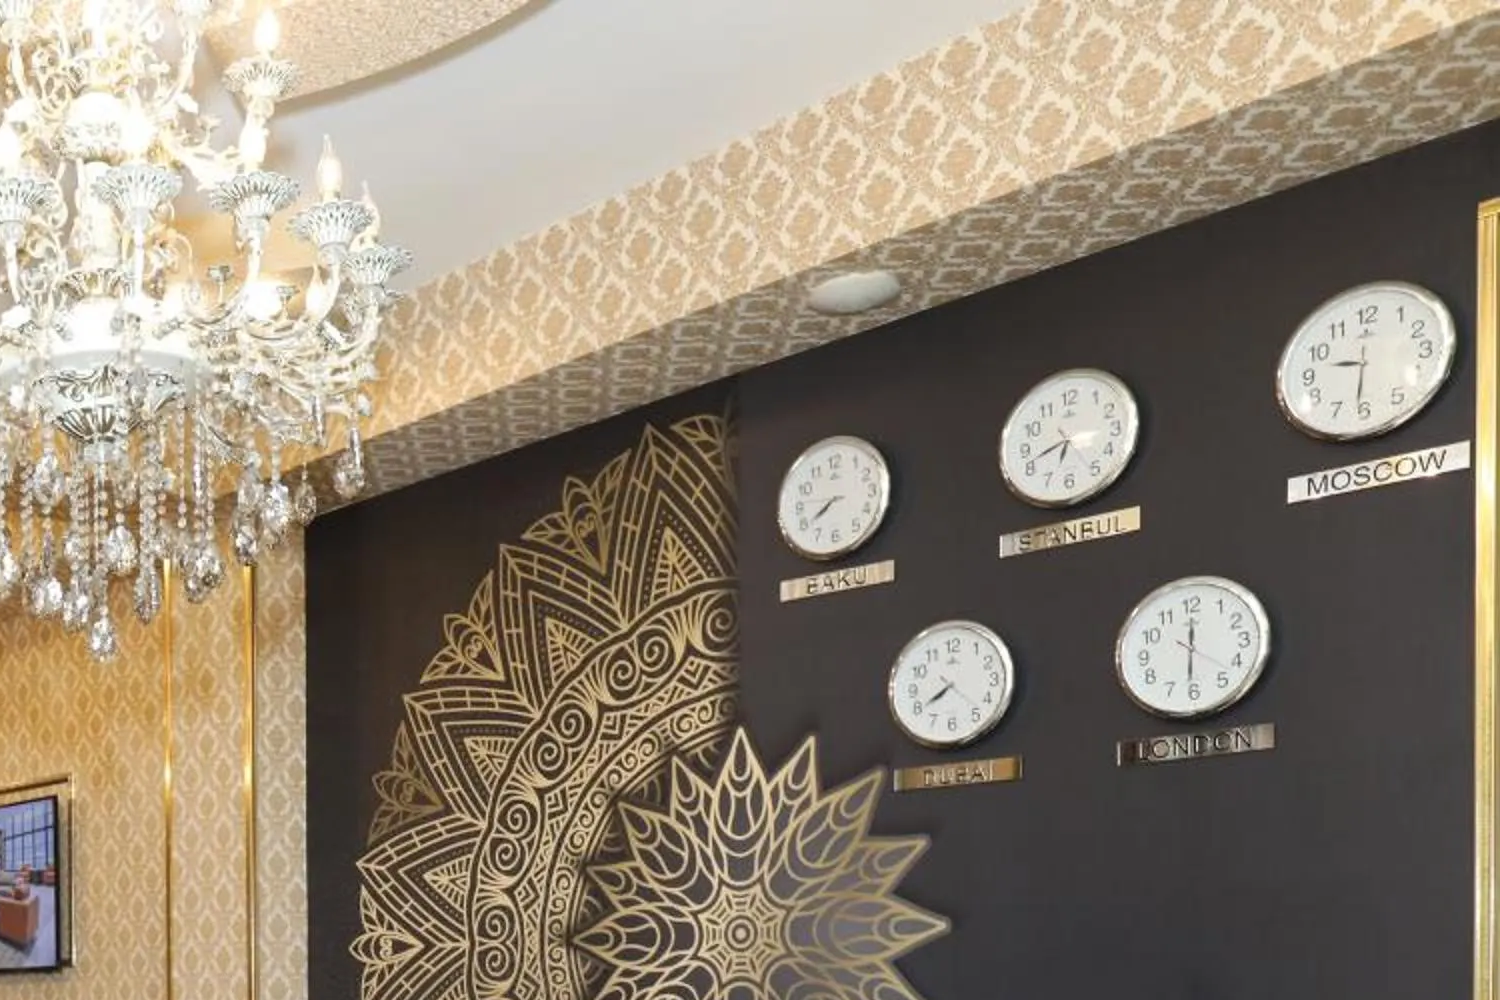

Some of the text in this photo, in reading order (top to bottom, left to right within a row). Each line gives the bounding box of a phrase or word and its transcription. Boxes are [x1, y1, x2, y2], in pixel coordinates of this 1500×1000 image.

[1357, 306, 1378, 324] 12
[1329, 320, 1345, 339] 11
[1411, 320, 1424, 338] 2
[1308, 343, 1330, 362] 10
[1419, 341, 1432, 359] 3
[1302, 368, 1315, 386] 9
[1062, 389, 1077, 406] 12
[1392, 387, 1404, 405] 5
[1040, 403, 1053, 417] 11
[1104, 403, 1114, 419] 2
[1330, 401, 1343, 418] 7
[1358, 402, 1371, 419] 6
[1025, 421, 1040, 437] 10
[1110, 421, 1121, 436] 3
[1020, 443, 1030, 458] 9
[1104, 442, 1113, 456] 4
[829, 454, 842, 469] 12
[1026, 460, 1035, 476] 8
[1090, 460, 1100, 477] 5
[811, 466, 821, 478] 11
[862, 467, 871, 482] 2
[1044, 472, 1053, 487] 7
[1307, 449, 1447, 496] MOSCOW
[799, 482, 812, 495] 10
[1064, 473, 1074, 489] 6
[868, 484, 877, 498] 3
[795, 503, 804, 515] 9
[800, 518, 808, 531] 8
[852, 518, 860, 532] 5
[814, 528, 821, 542] 7
[831, 530, 841, 542] 6
[806, 566, 867, 595] BAKU
[1183, 595, 1200, 614] 12
[1158, 609, 1173, 625] 11
[1231, 612, 1242, 630] 2
[1142, 627, 1160, 645] 10
[1238, 631, 1250, 648] 3
[945, 638, 961, 653] 12
[926, 649, 938, 662] 11
[983, 655, 993, 670] 2
[1137, 650, 1149, 666] 9
[1232, 653, 1242, 668] 4
[913, 664, 927, 679] 10
[989, 671, 999, 687] 3
[1145, 668, 1156, 684] 8
[1217, 672, 1228, 688] 5
[908, 683, 918, 698] 9
[1164, 682, 1175, 696] 7
[1188, 683, 1200, 700] 6
[983, 691, 992, 704] 4
[914, 701, 922, 715] 8
[971, 708, 980, 722] 5
[929, 712, 939, 726] 7
[948, 717, 957, 731] 6
[1139, 728, 1252, 760] LONDON
